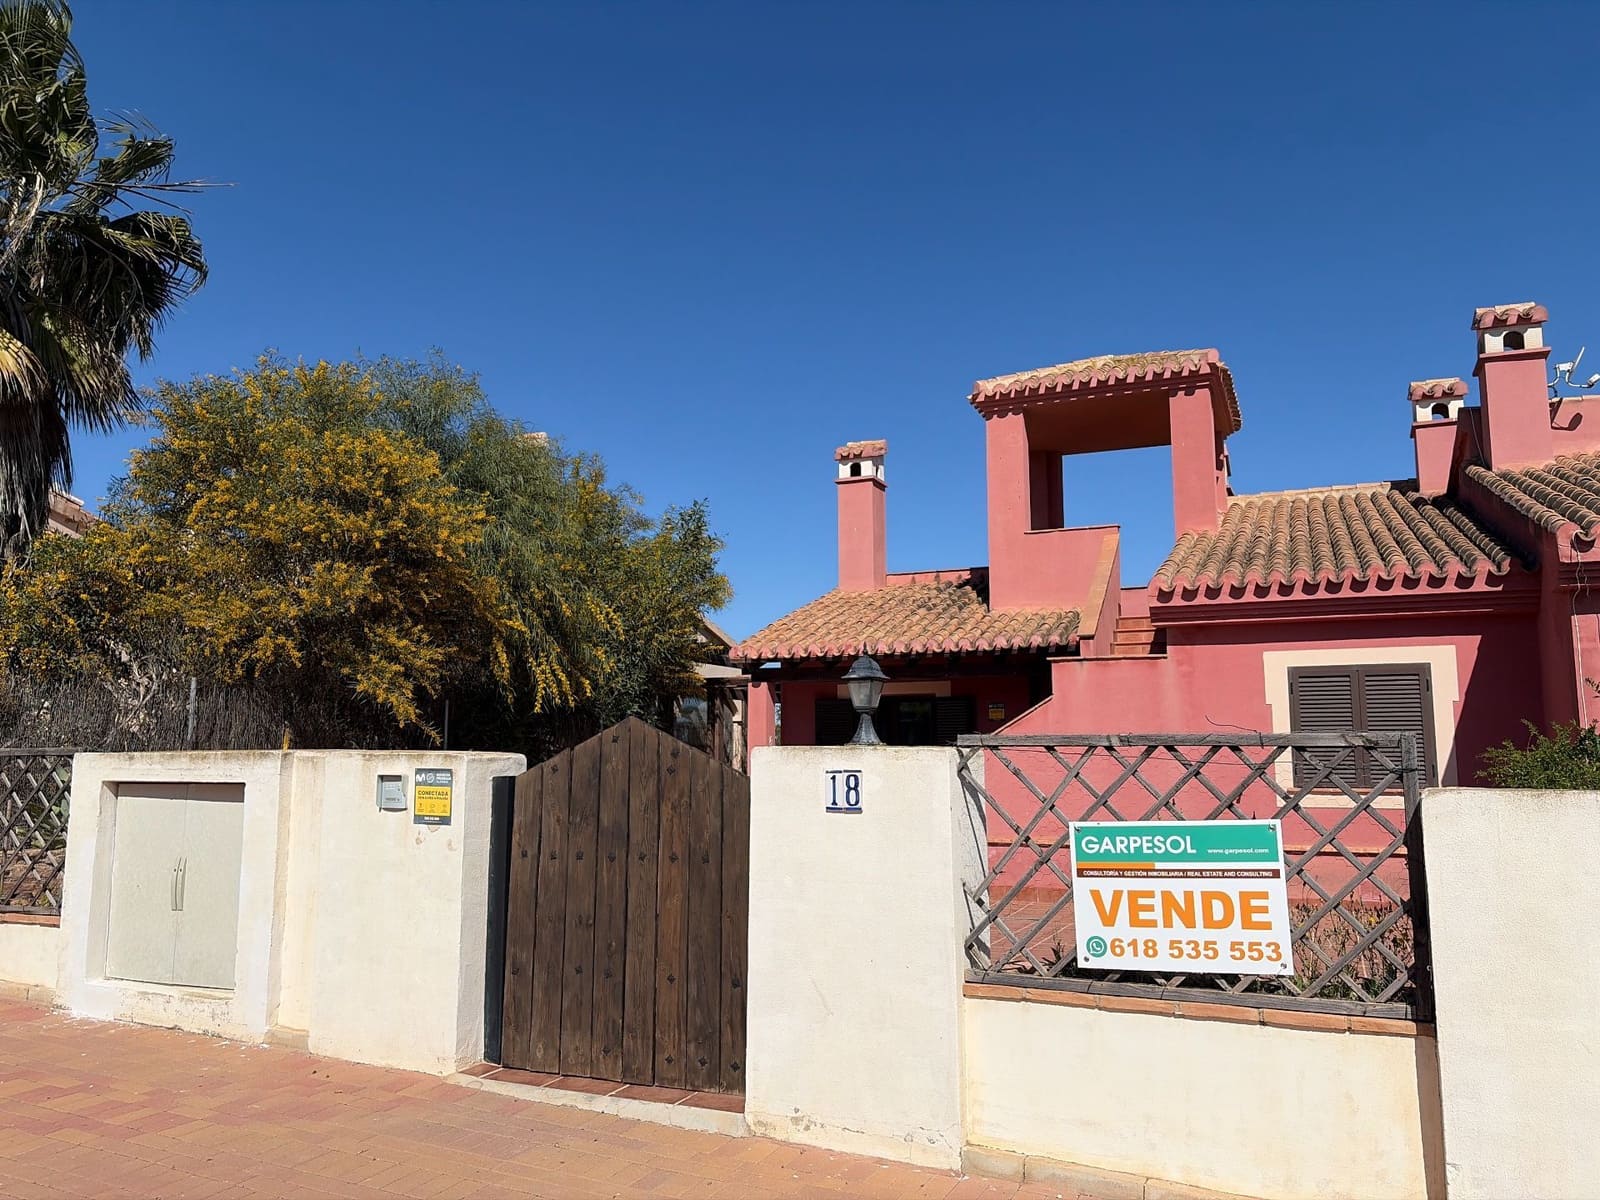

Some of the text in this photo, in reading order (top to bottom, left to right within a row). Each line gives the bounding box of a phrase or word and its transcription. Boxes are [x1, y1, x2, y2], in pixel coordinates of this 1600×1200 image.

[830, 774, 860, 806] 18
[1081, 835, 1197, 854] GARPESOL
[1089, 889, 1273, 930] VENDE
[1109, 937, 1283, 962] 618 535 553
